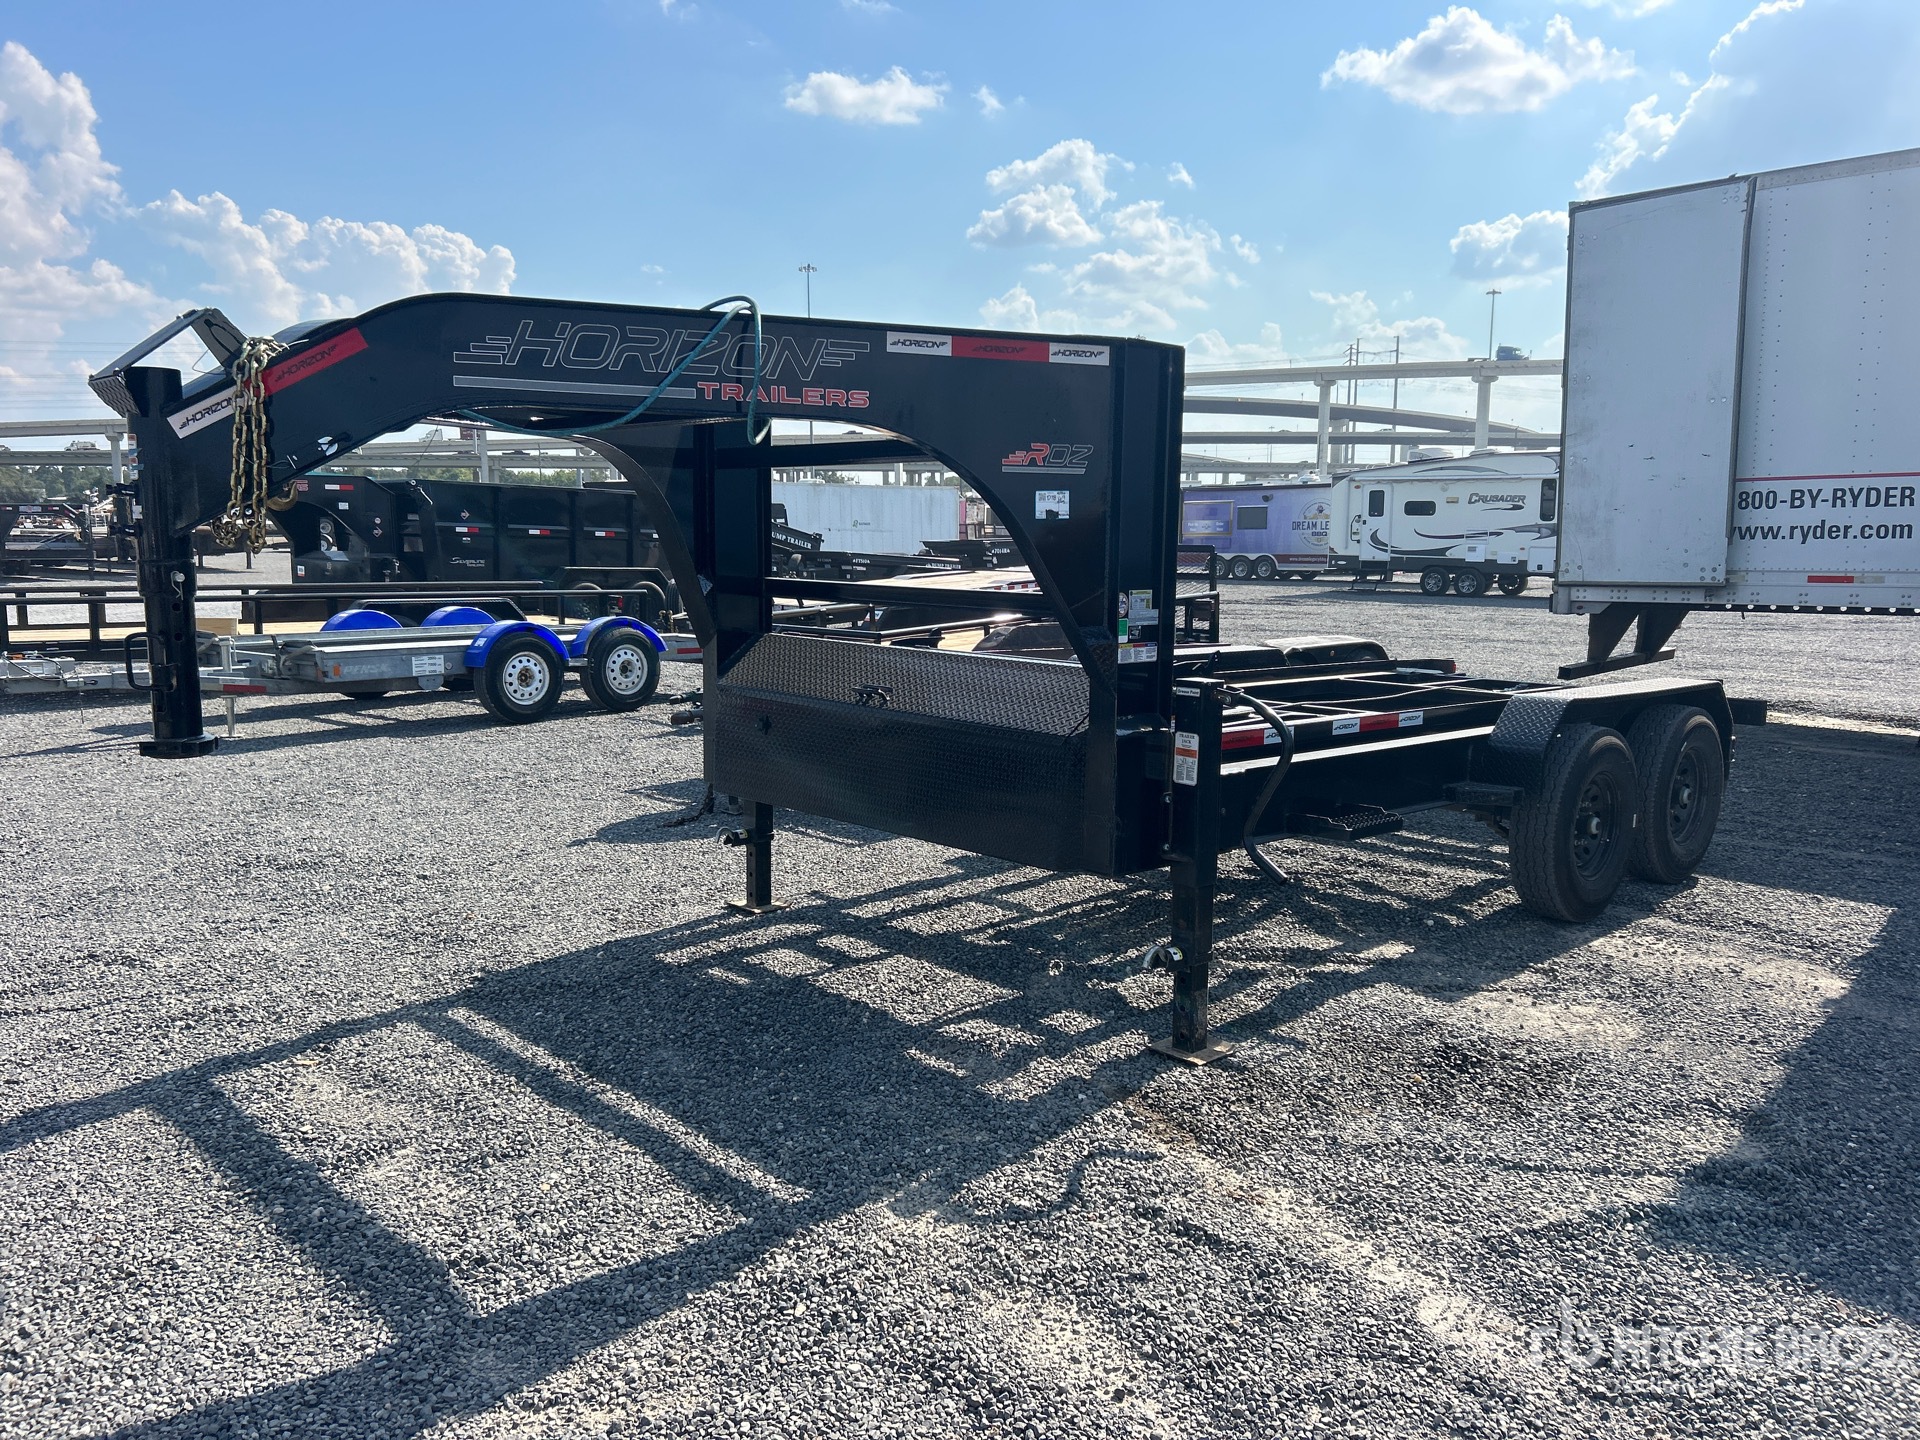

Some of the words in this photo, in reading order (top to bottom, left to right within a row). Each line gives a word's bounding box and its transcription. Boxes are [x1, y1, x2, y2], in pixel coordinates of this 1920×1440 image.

[506, 319, 828, 381] HORIZON
[897, 339, 941, 349] HORIZON
[1057, 348, 1098, 358] HORIZON
[697, 381, 870, 409] TRAILERS
[1022, 442, 1094, 467] RDZ
[1467, 492, 1527, 506] CRUSADER
[1291, 521, 1318, 530] DREAM
[1731, 519, 1913, 544] ww.ryder.com
[771, 531, 786, 541] UMP
[787, 536, 813, 549] TRAILER
[344, 663, 393, 675] PENSK
